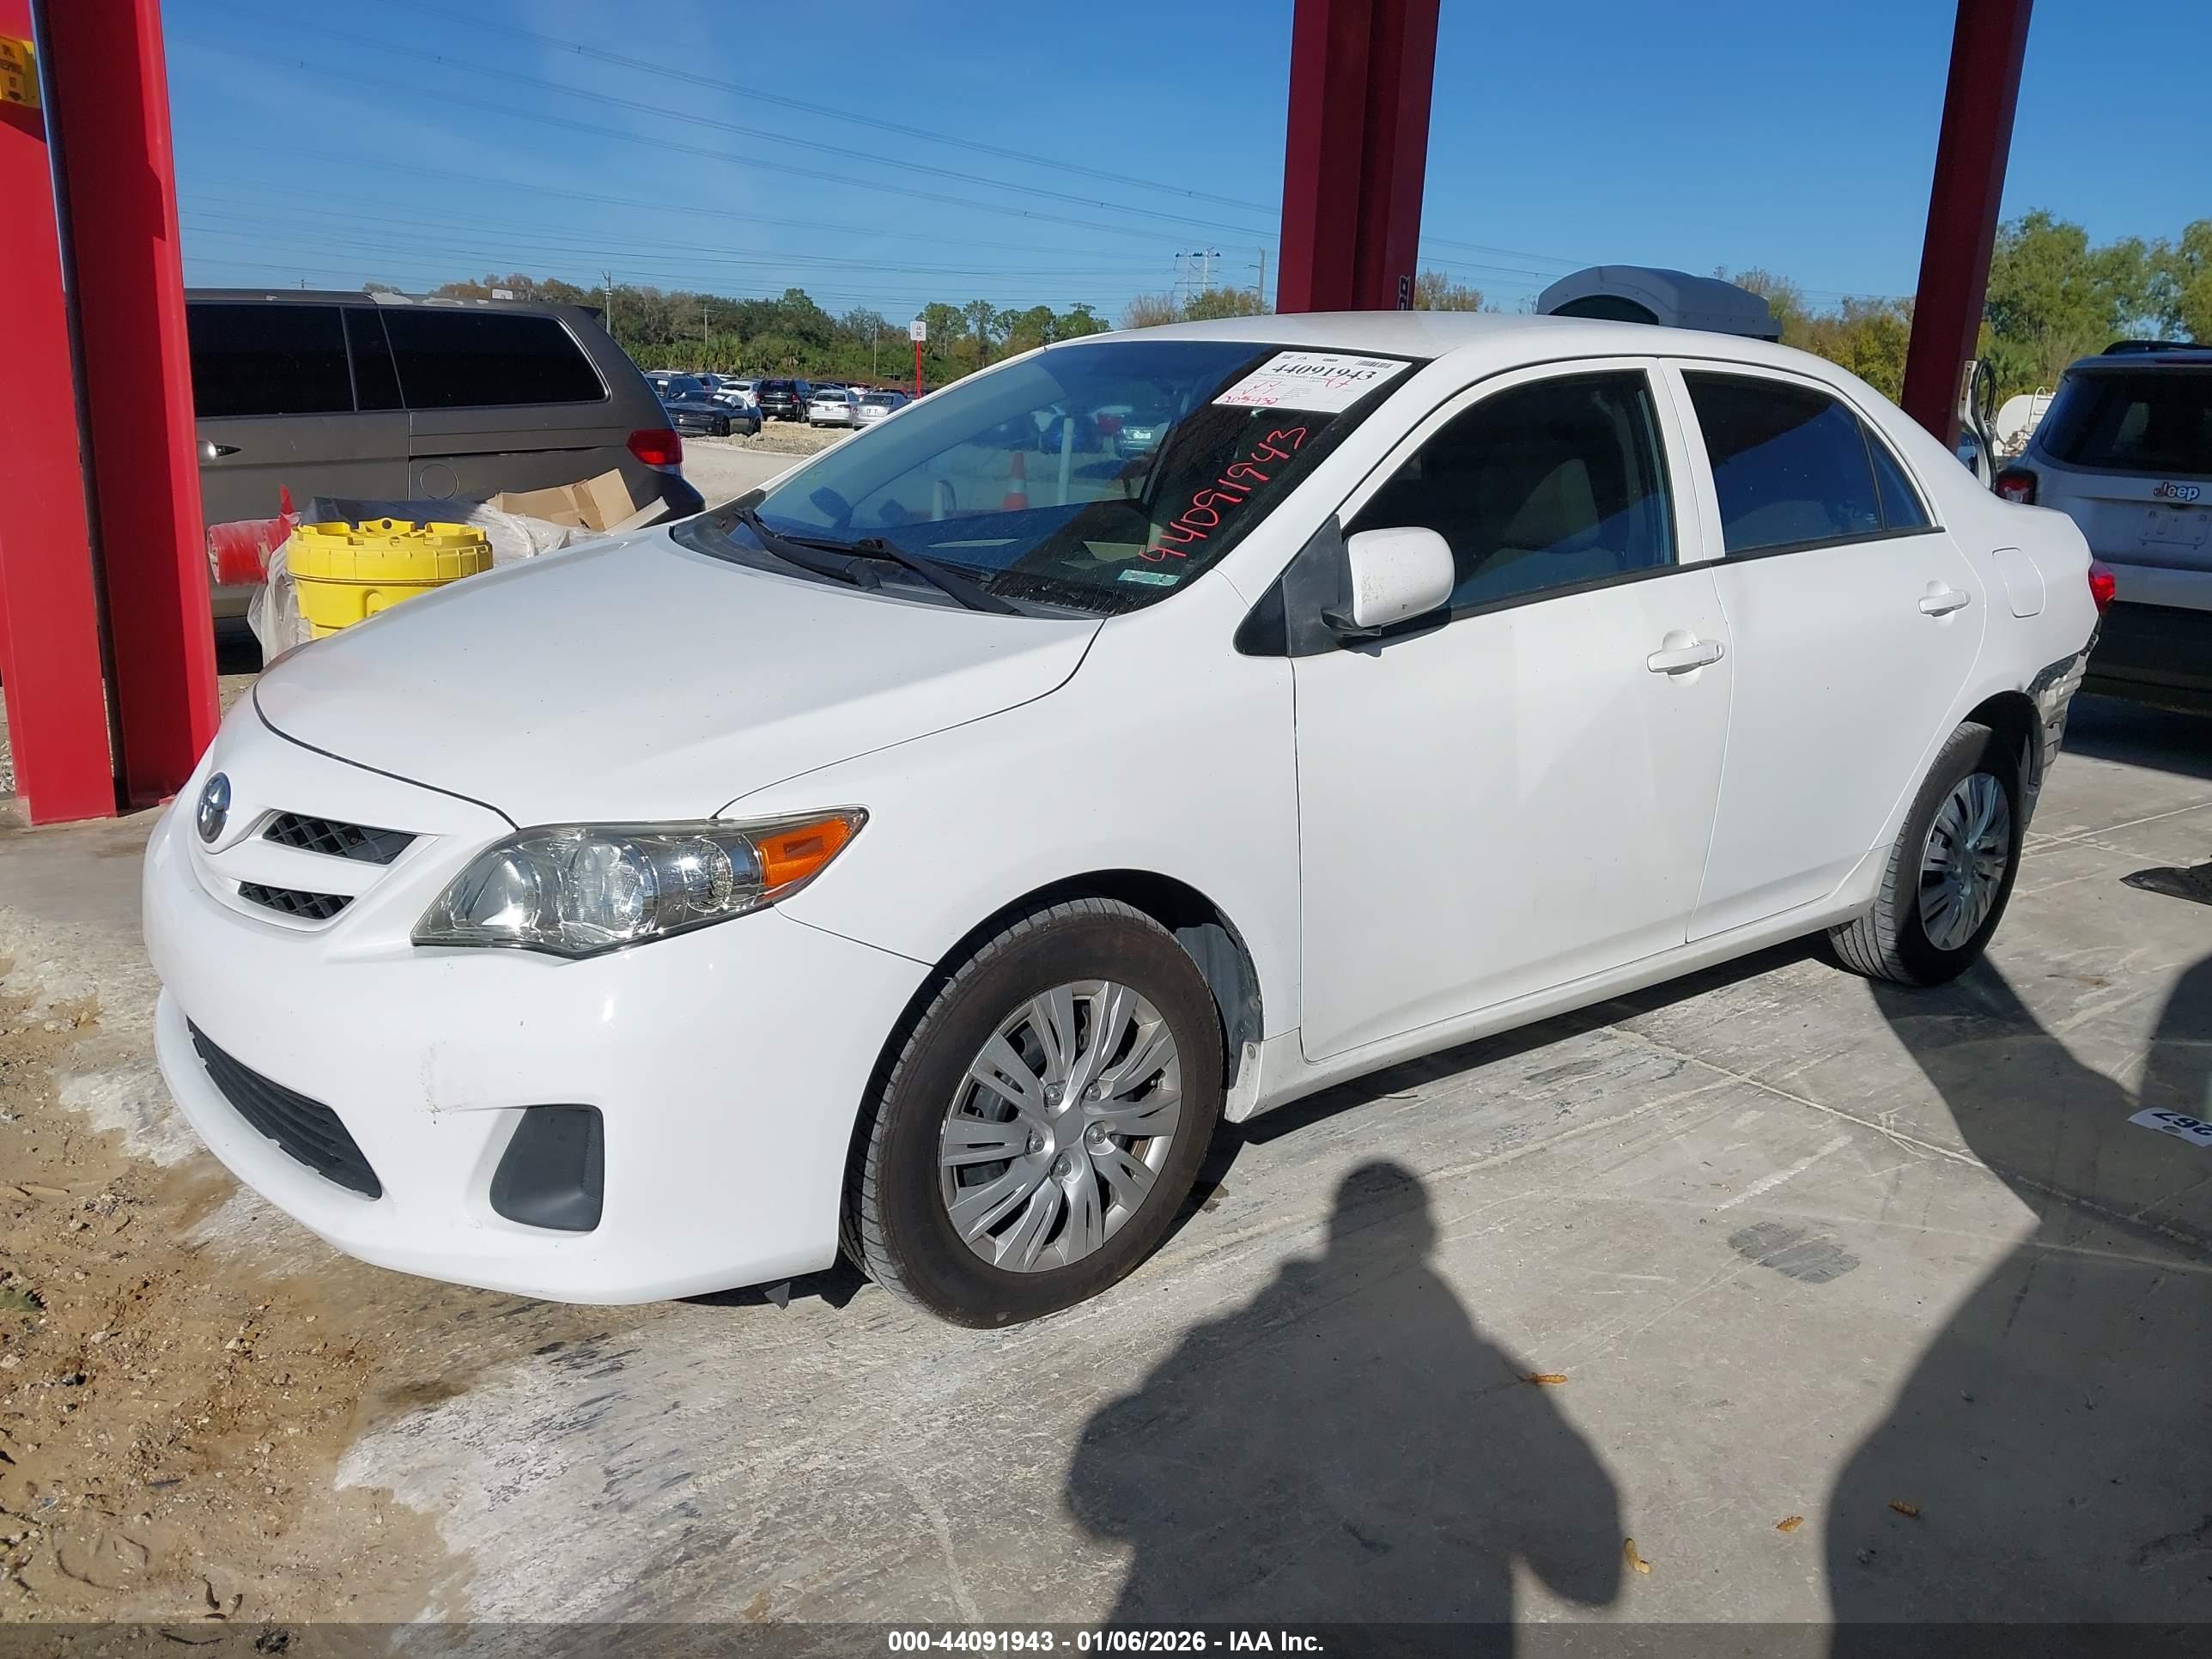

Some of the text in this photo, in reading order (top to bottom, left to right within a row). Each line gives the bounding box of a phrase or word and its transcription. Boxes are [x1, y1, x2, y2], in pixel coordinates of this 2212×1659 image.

[1272, 363, 1377, 380] 44091943
[1139, 427, 1307, 562] 44091943
[2154, 482, 2200, 501] Jeep
